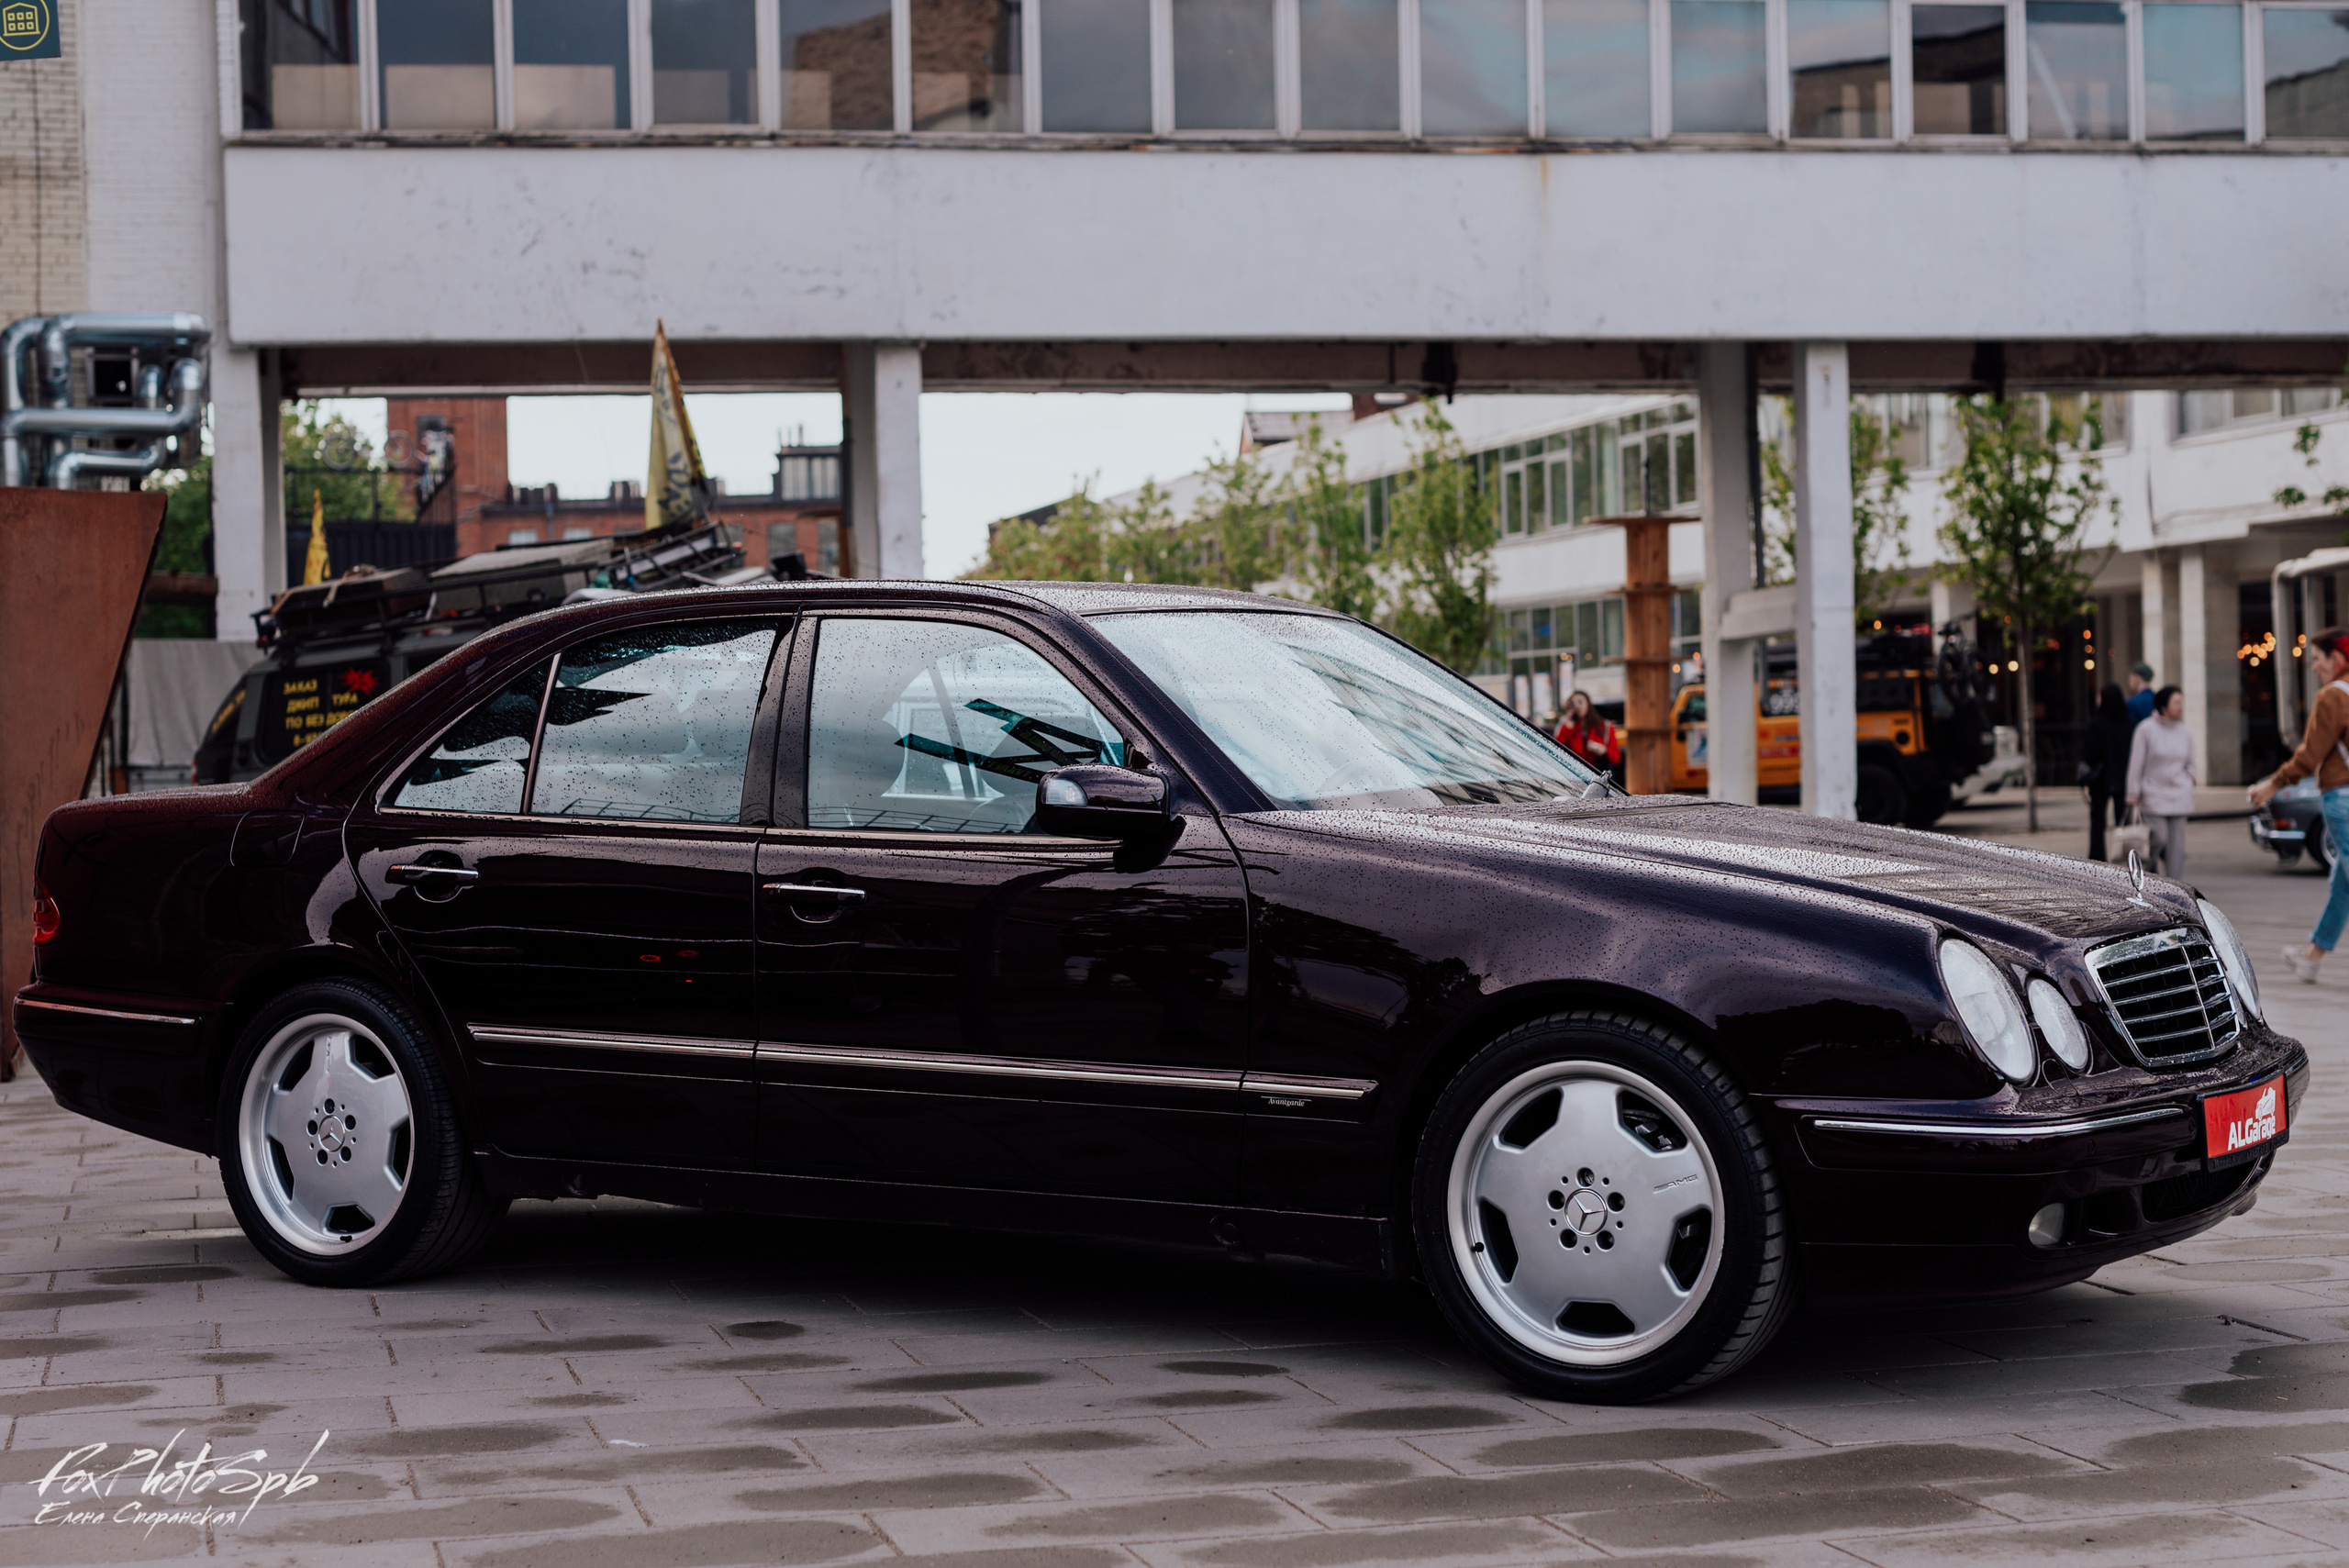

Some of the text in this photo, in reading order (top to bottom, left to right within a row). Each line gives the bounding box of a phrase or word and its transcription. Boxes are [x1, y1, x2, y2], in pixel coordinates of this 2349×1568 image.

[284, 679, 318, 695] ЗАКАЗ
[286, 691, 359, 714] ДЖИП ТУРА
[285, 716, 304, 730] ПО
[306, 713, 325, 728] БЕЗ
[1268, 1098, 1305, 1106] Avantgarde
[2227, 1115, 2277, 1151] ALGarage
[1664, 1173, 1698, 1190] AMG
